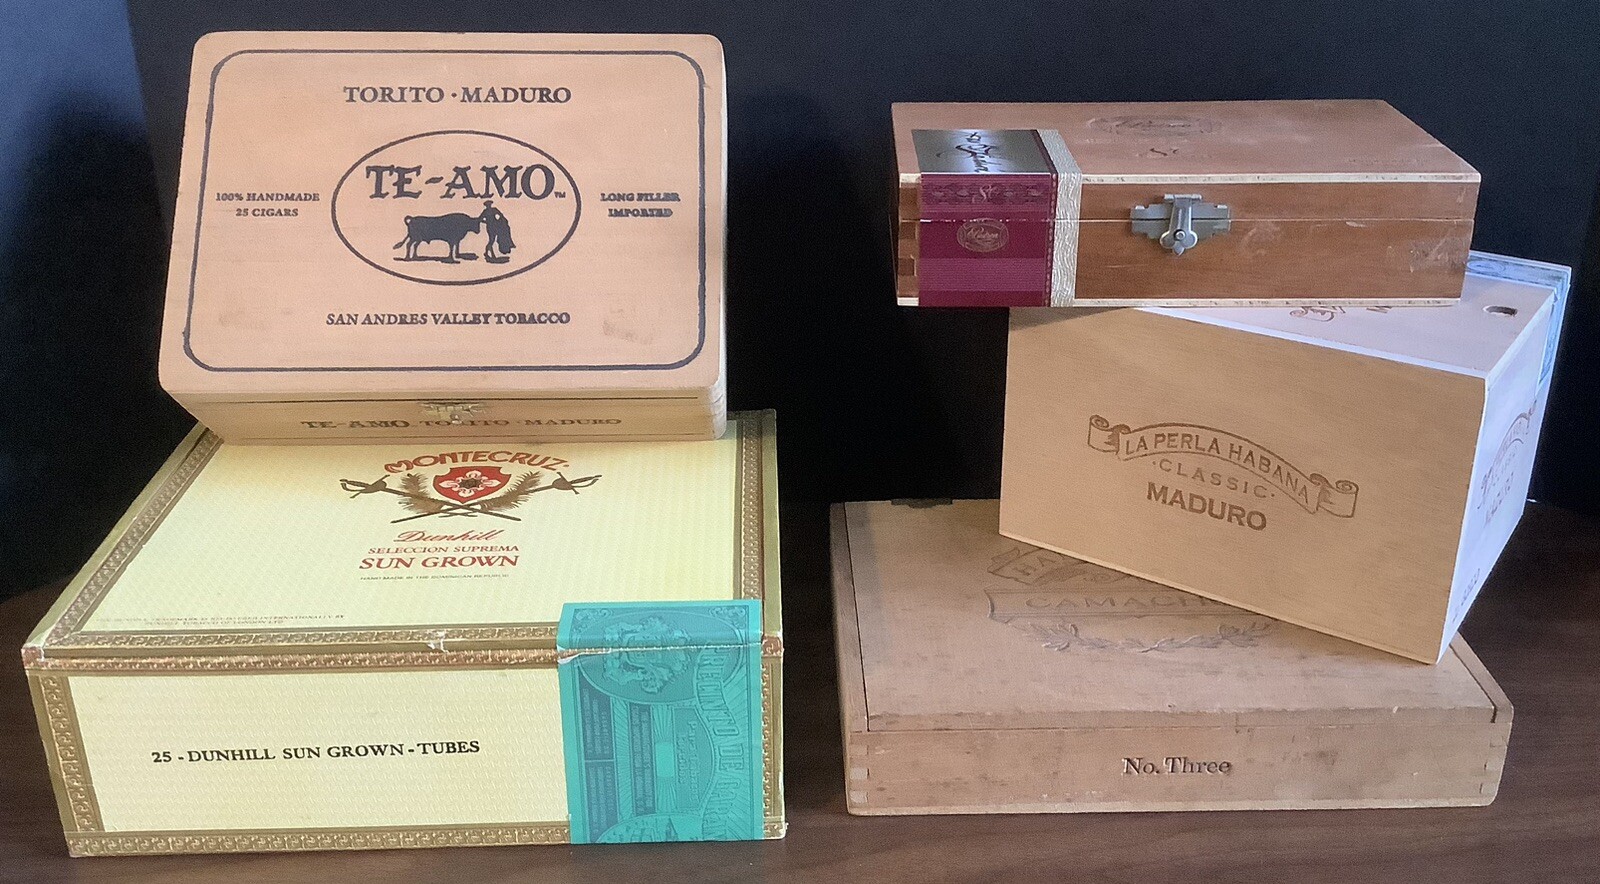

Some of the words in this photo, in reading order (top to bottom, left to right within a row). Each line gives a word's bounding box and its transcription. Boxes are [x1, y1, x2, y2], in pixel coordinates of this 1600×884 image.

[343, 85, 445, 104] TORITO
[460, 85, 572, 104] MADURO
[365, 164, 555, 200] TE-AMO
[215, 192, 244, 202] 100%
[246, 192, 321, 202] HANDMADE
[600, 192, 635, 202] LONG
[636, 192, 682, 202] FILLER
[235, 207, 249, 217] 25
[251, 207, 299, 217] CIGARS
[607, 207, 674, 218] IMPORTED
[325, 313, 360, 326] SAN
[361, 313, 428, 326] ANDRES
[431, 312, 494, 325] VALLEY
[494, 312, 571, 325] TOBACCO
[300, 420, 411, 429] TE-AMO
[524, 418, 622, 427] MADURO
[384, 450, 564, 474] MONTECRUZ
[1124, 434, 1149, 456] LA
[1153, 431, 1221, 457] PERLA
[1228, 443, 1310, 504] HABANA
[1158, 457, 1269, 500] CLASSIC
[1146, 481, 1268, 532] MADURO
[393, 529, 506, 542] Dunhill
[367, 546, 449, 555] SELECCION
[453, 544, 520, 553] SUPREMA
[358, 556, 415, 570] SUN
[420, 554, 520, 569] GROWN
[1025, 595, 1213, 609] CAMACH
[151, 751, 172, 763] 25
[187, 748, 276, 763] DUNHILL
[283, 746, 321, 761] SUN
[326, 743, 405, 759] GROWN
[416, 740, 481, 756] TUBES
[718, 743, 745, 772] DE
[1121, 757, 1160, 775] No.
[1164, 756, 1233, 775] Three
